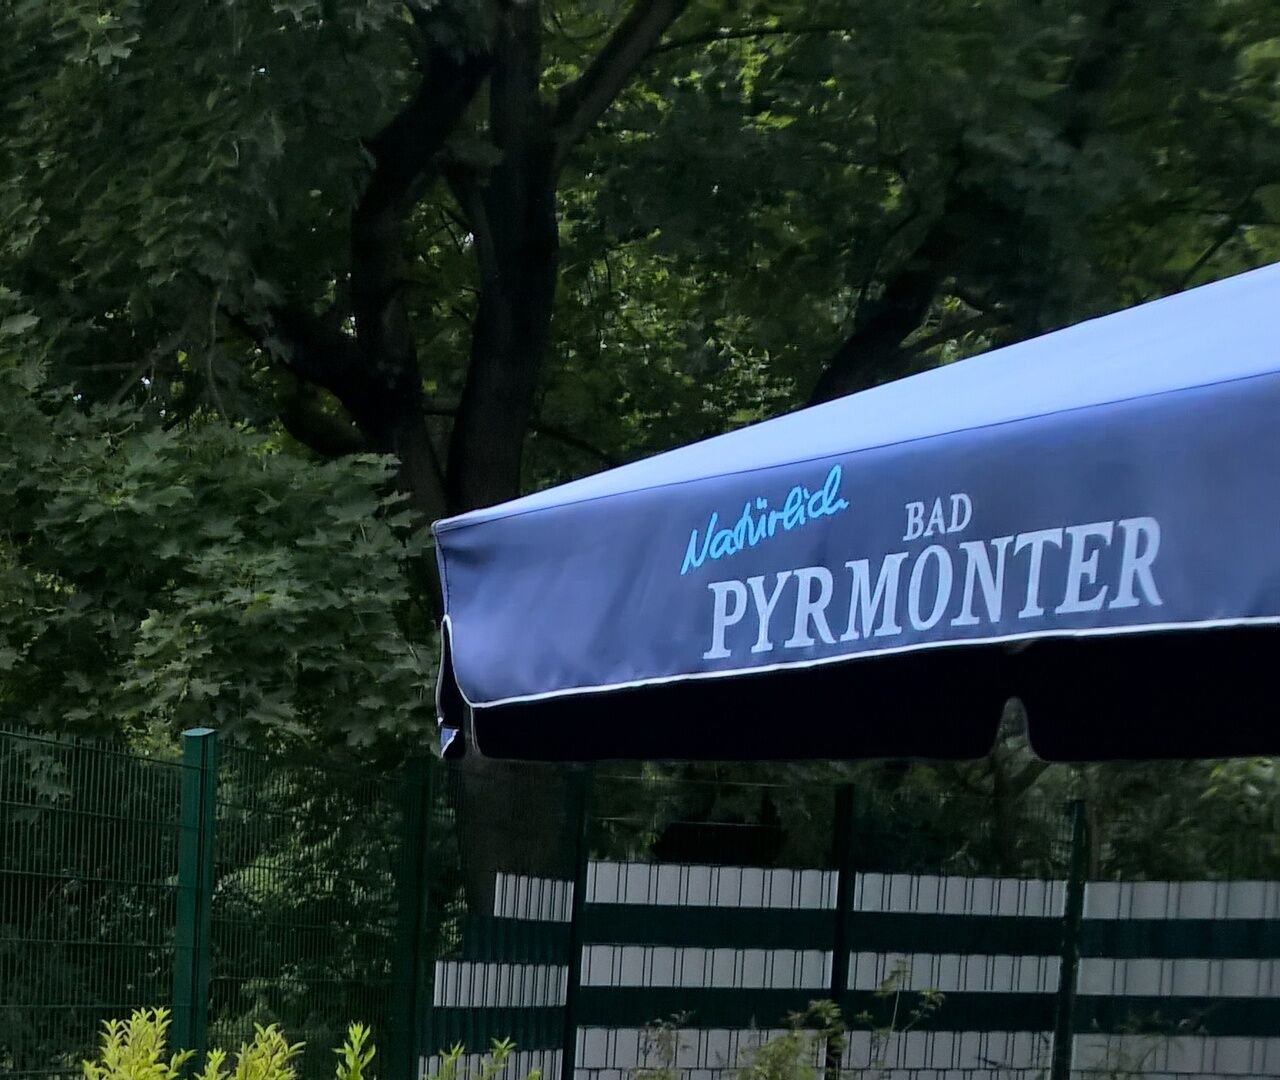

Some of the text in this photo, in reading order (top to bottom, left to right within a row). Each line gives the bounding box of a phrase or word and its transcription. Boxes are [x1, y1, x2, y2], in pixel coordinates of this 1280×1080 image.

[680, 464, 849, 576] Natürlich
[903, 493, 973, 542] BAD
[702, 516, 1164, 660] PYRMONTER
